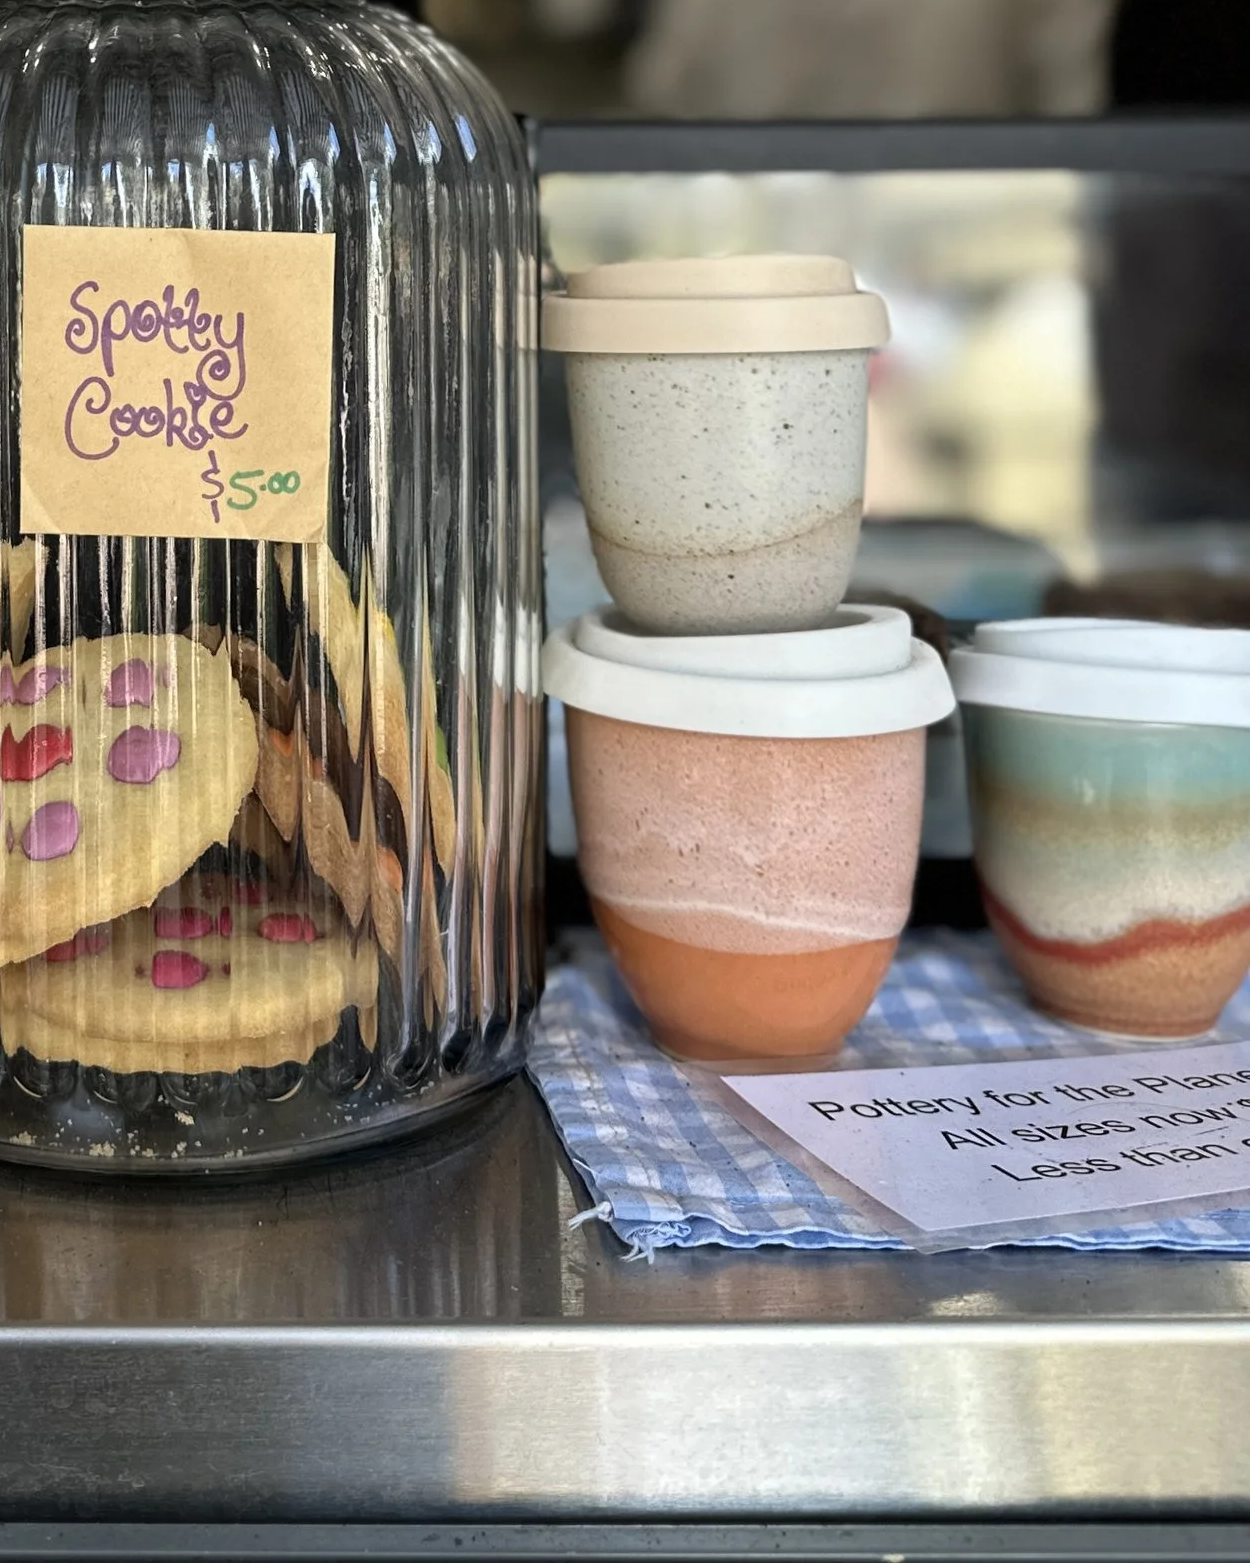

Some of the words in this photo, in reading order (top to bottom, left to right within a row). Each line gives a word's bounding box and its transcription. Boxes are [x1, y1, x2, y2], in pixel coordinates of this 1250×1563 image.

[65, 281, 247, 401] Spotty
[64, 376, 249, 461] Cookie
[201, 450, 301, 524] $5.00
[808, 1096, 982, 1121] Pottery
[982, 1090, 1052, 1108] for
[1053, 1084, 1136, 1102] the
[940, 1127, 1008, 1150] All
[1011, 1120, 1137, 1142] sizes
[1138, 1106, 1238, 1129] now
[990, 1158, 1122, 1182] Less
[1118, 1144, 1239, 1167] than
